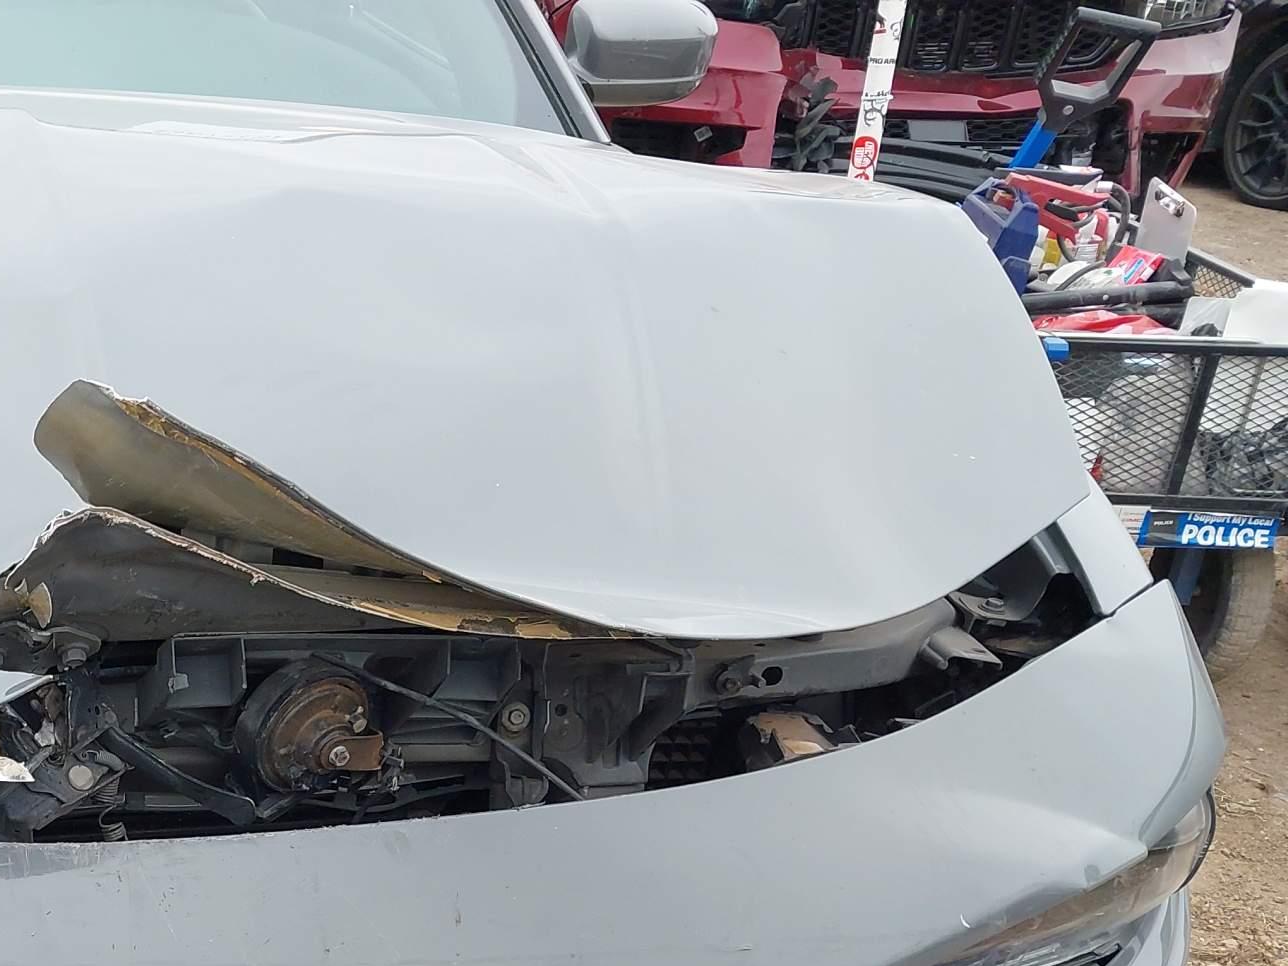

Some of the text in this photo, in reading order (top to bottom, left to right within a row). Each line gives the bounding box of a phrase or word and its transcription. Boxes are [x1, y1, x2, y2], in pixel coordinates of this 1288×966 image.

[1193, 513, 1231, 525] Support
[1231, 515, 1248, 526] My
[1247, 518, 1275, 527] Local
[1181, 524, 1270, 548] POLICE
